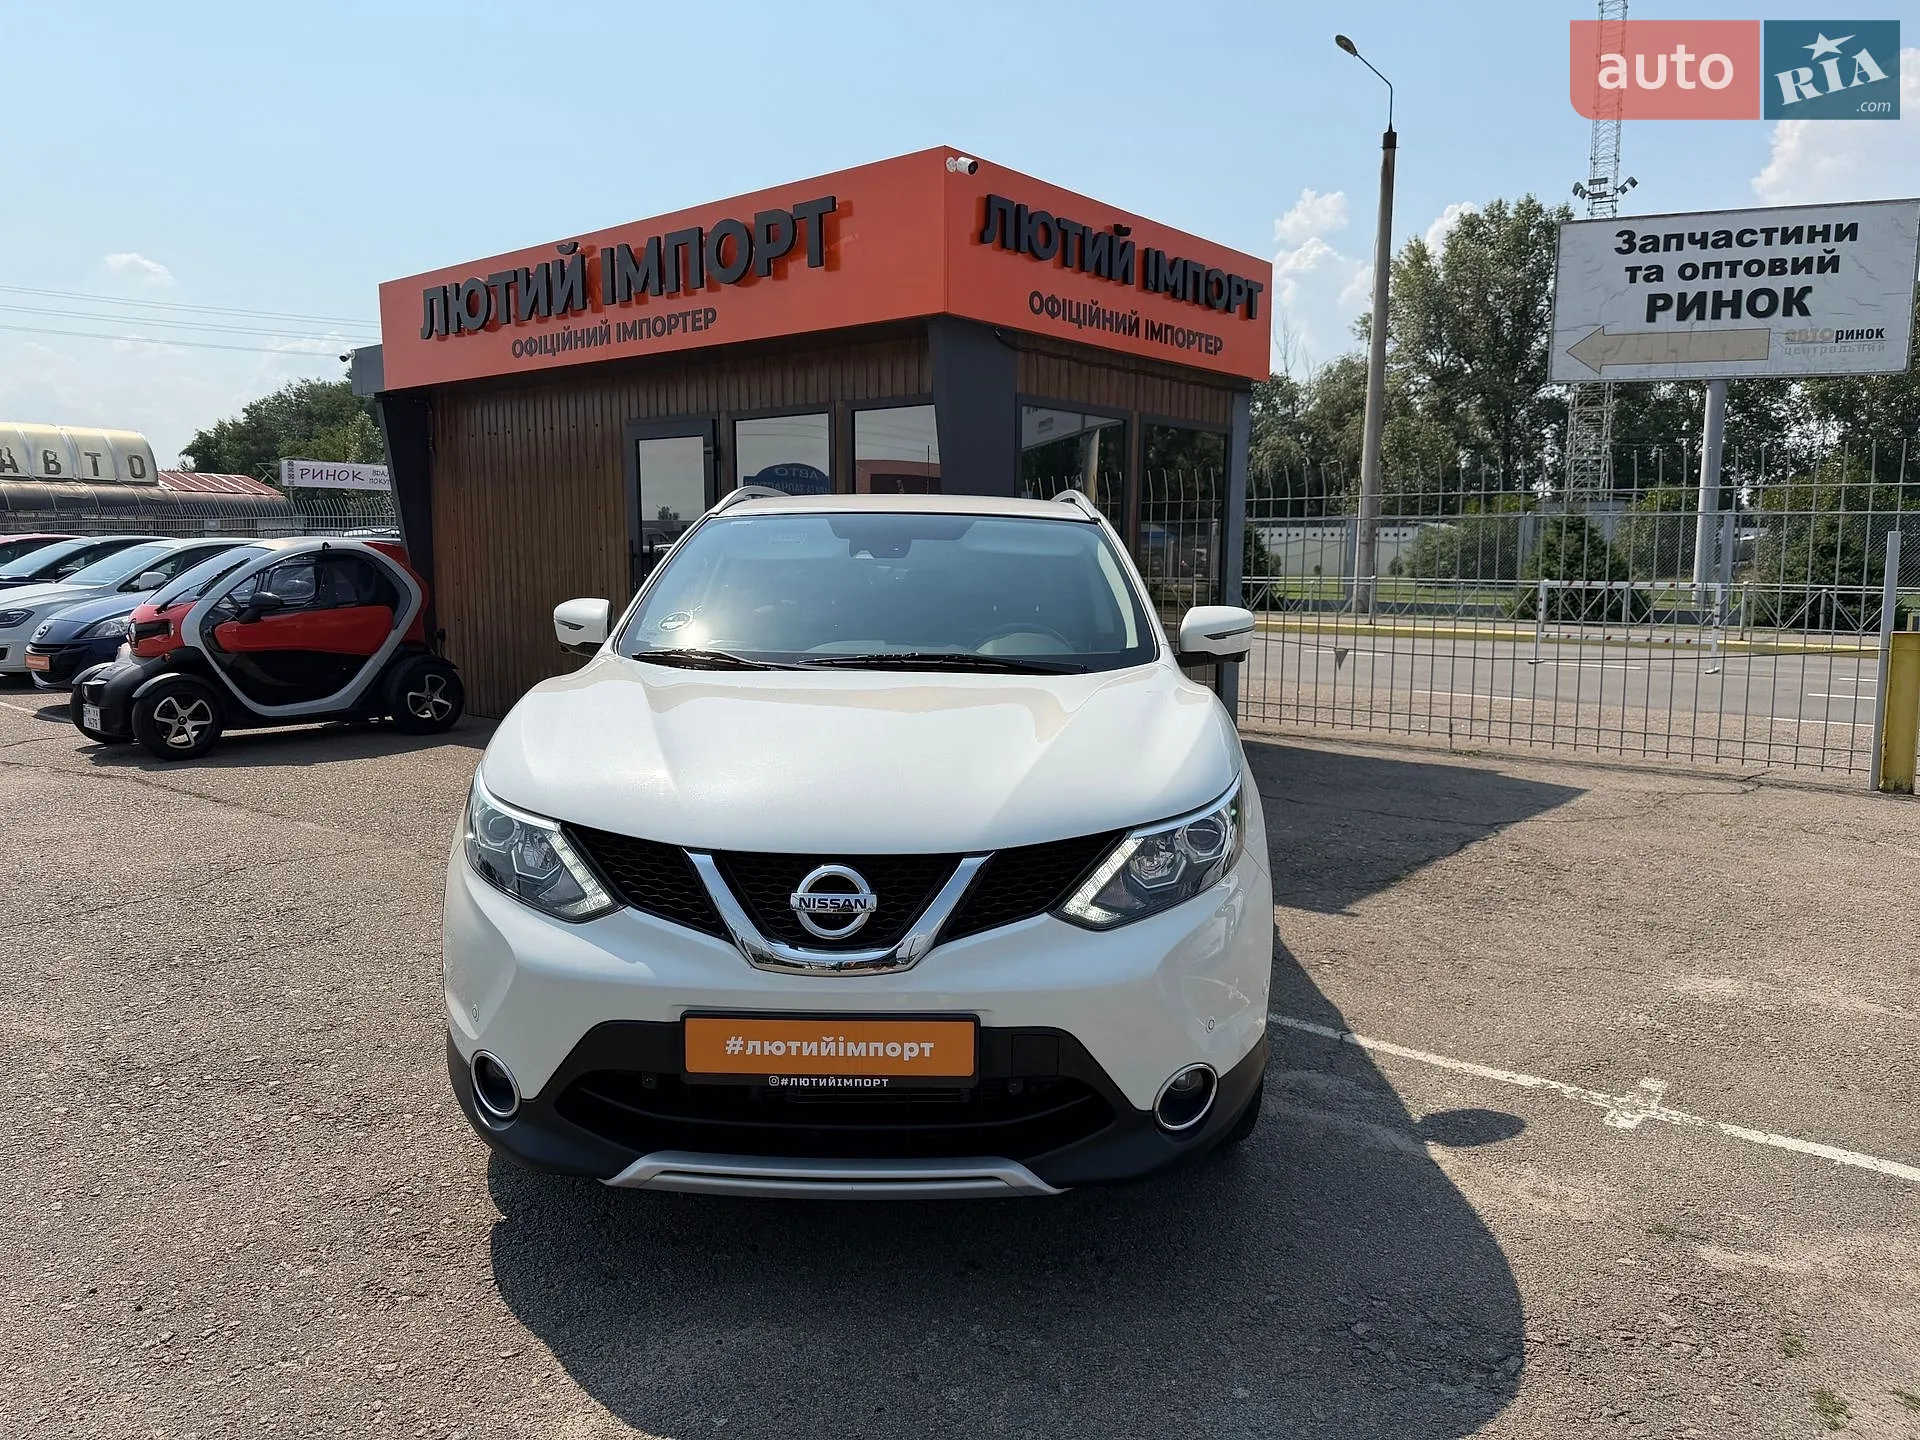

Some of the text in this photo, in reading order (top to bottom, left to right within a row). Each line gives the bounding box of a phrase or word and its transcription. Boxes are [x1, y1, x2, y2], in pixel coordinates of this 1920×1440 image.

[1614, 222, 1860, 255] Запчастини
[421, 195, 837, 340] ЛЮТИЙ ІМПОРТ
[980, 194, 1264, 320] ЛЮТИЙ ІМПОРТ
[1625, 248, 1841, 284] та оптовий
[1646, 286, 1813, 323] РИНОК
[511, 307, 718, 359] ОФІЦІЙНИЙ ІМПОРТЕР
[1029, 290, 1223, 356] ОФІЦІЙНИЙ ІМПОРТЕР
[0, 447, 147, 479] АВТО
[299, 468, 365, 482] РИНОК
[799, 897, 868, 910] NISSAN
[725, 1036, 935, 1061] #лютийімпорт
